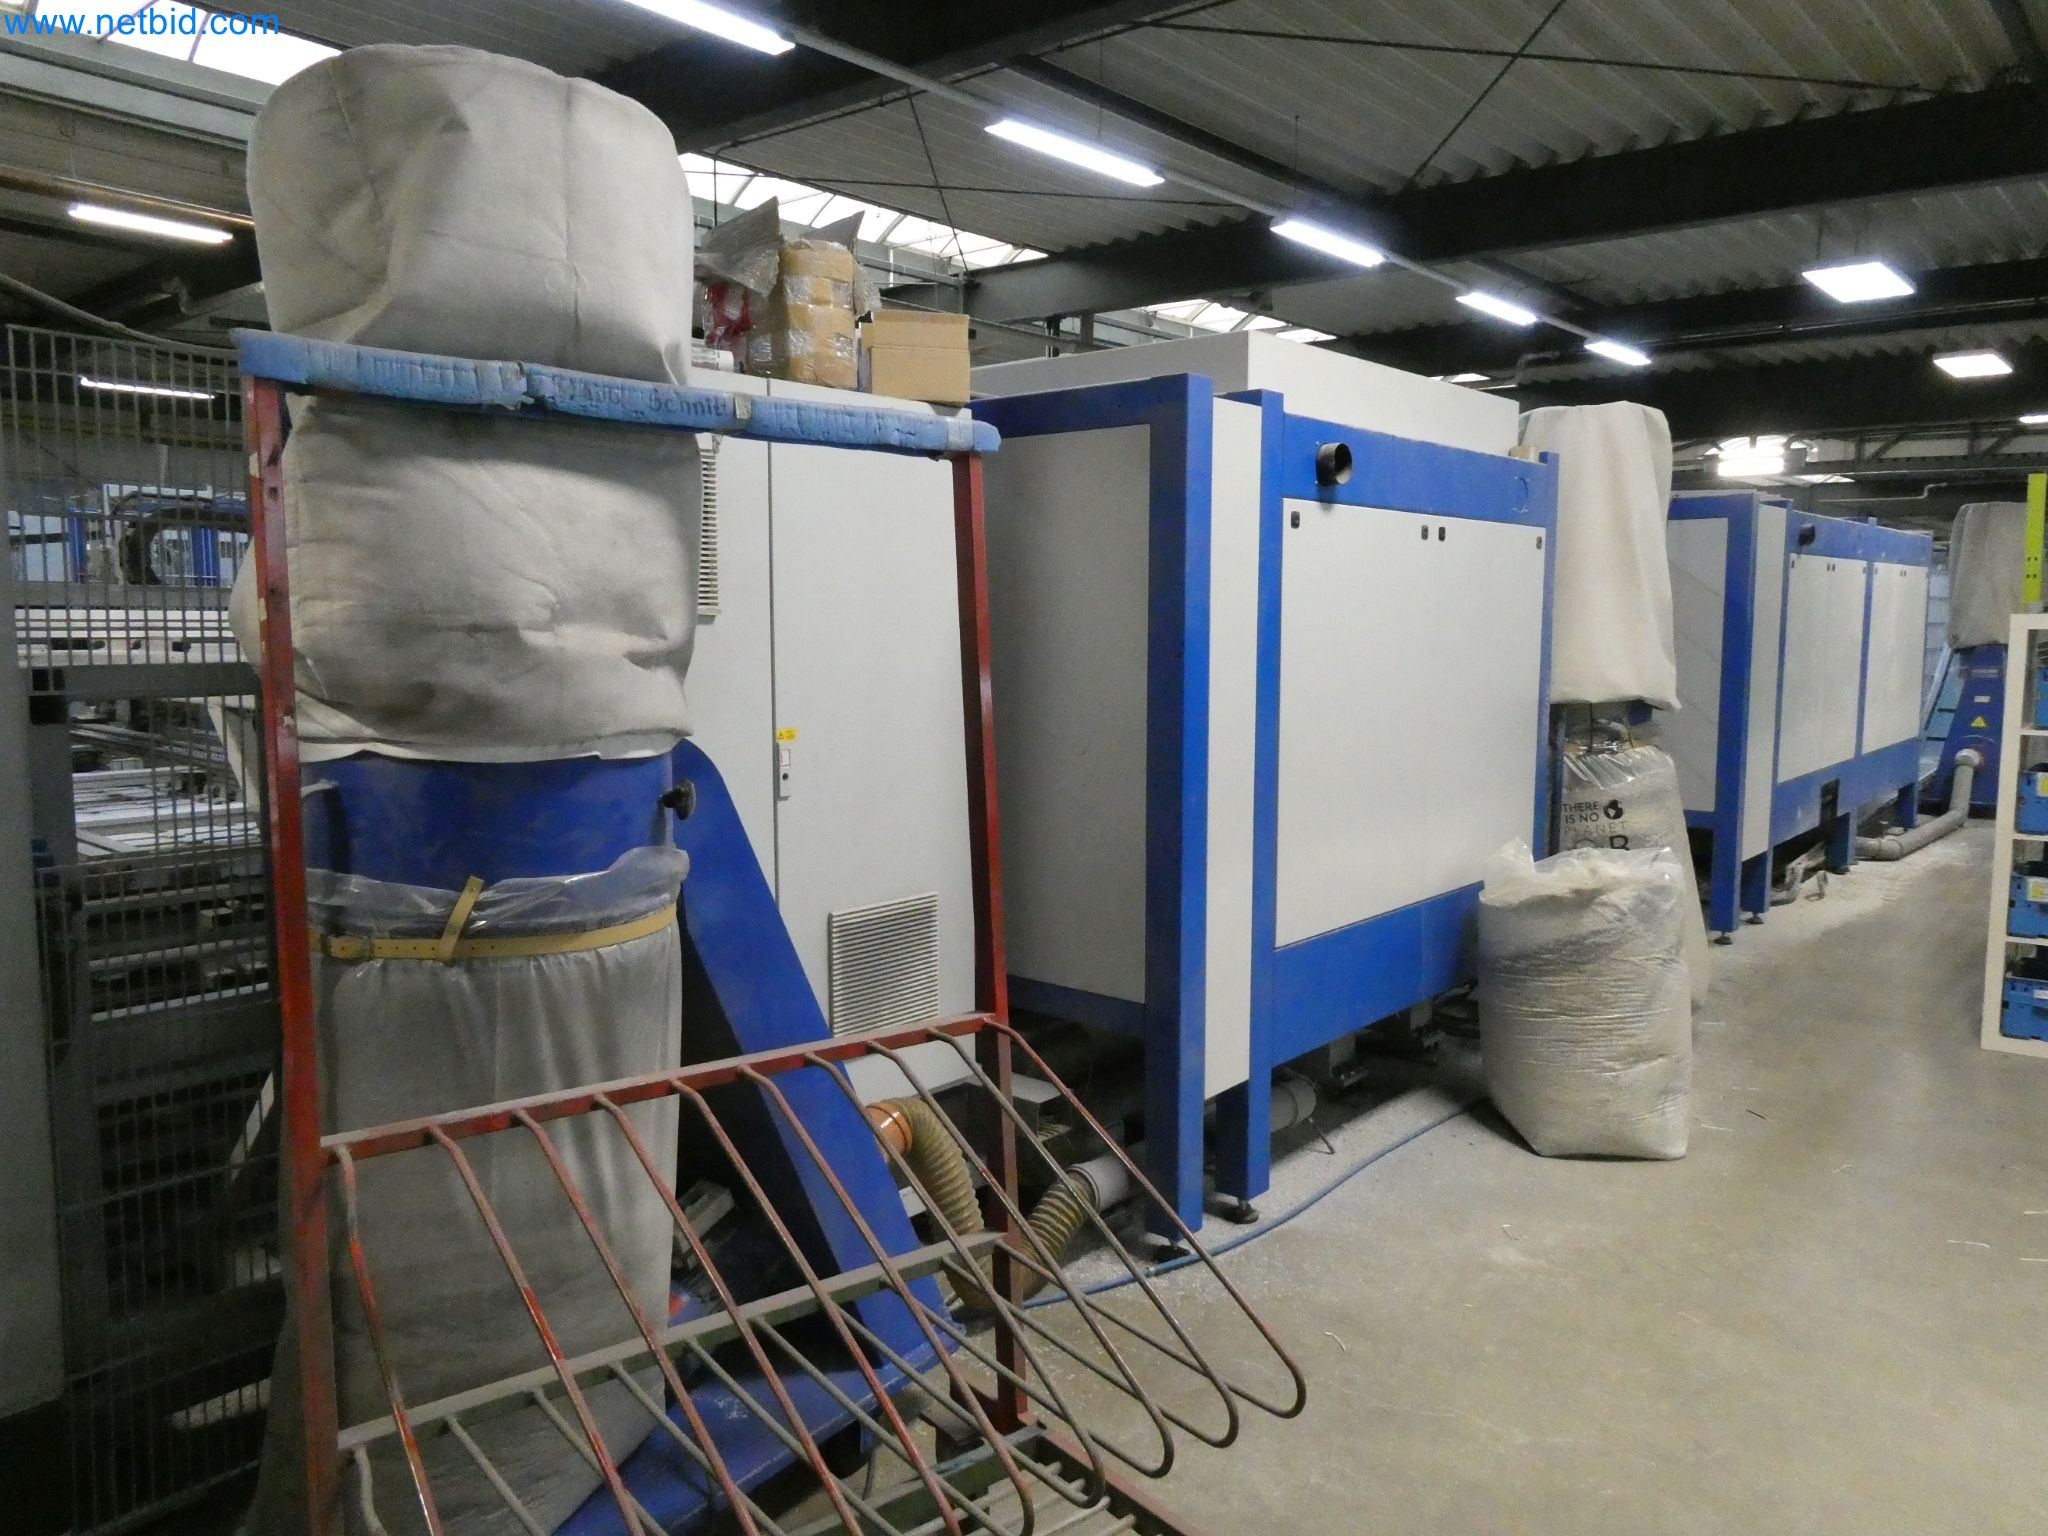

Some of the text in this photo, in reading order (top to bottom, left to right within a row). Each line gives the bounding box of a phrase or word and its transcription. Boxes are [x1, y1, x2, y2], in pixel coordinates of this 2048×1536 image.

[1561, 801, 1600, 813] THERE
[1564, 812, 1600, 825] IS NO
[1562, 820, 1627, 834] PLANET
